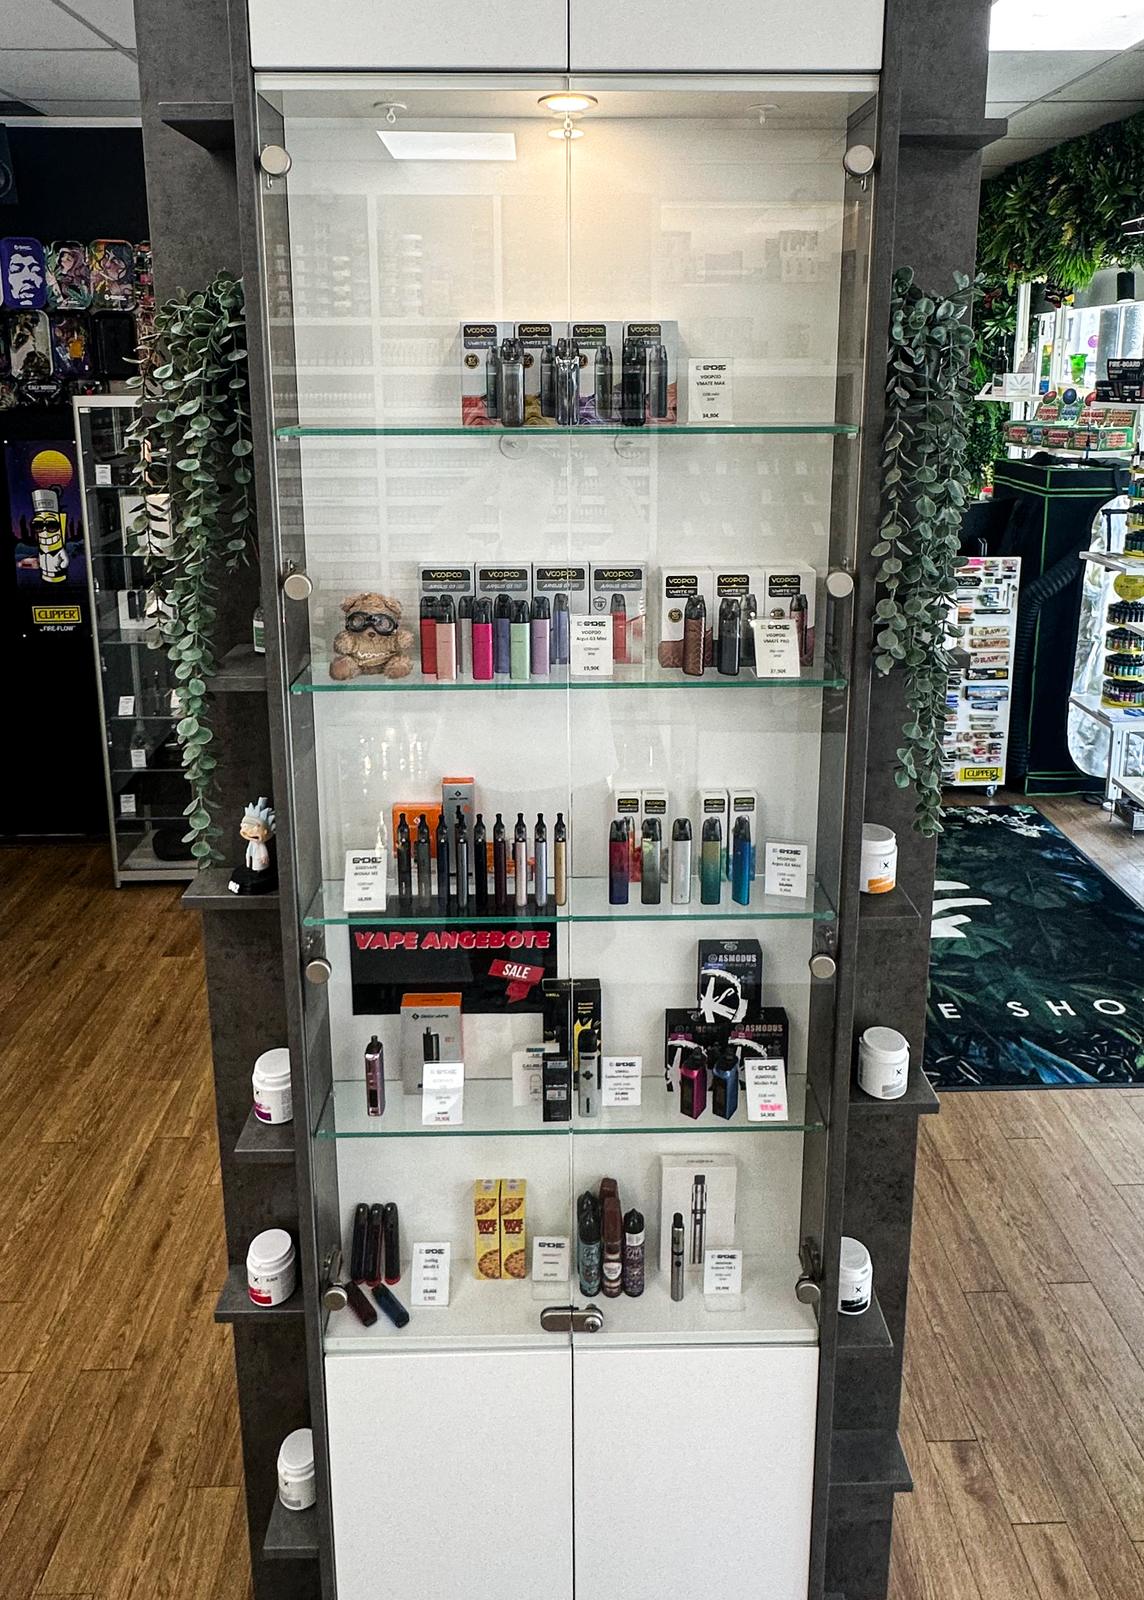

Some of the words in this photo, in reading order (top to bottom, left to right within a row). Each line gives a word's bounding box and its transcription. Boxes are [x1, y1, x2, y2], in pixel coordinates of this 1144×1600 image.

[38, 609, 76, 620] CLIPPER
[980, 655, 999, 663] RAW
[967, 769, 995, 778] CLIPPER
[354, 931, 418, 949] VAPE
[420, 931, 551, 949] ANGEBOTE
[718, 954, 757, 962] ASMODUS
[502, 963, 532, 979] SALE
[937, 1003, 961, 1018] E
[1006, 999, 1144, 1017] SHO
[745, 1024, 783, 1032] ASMODUS
